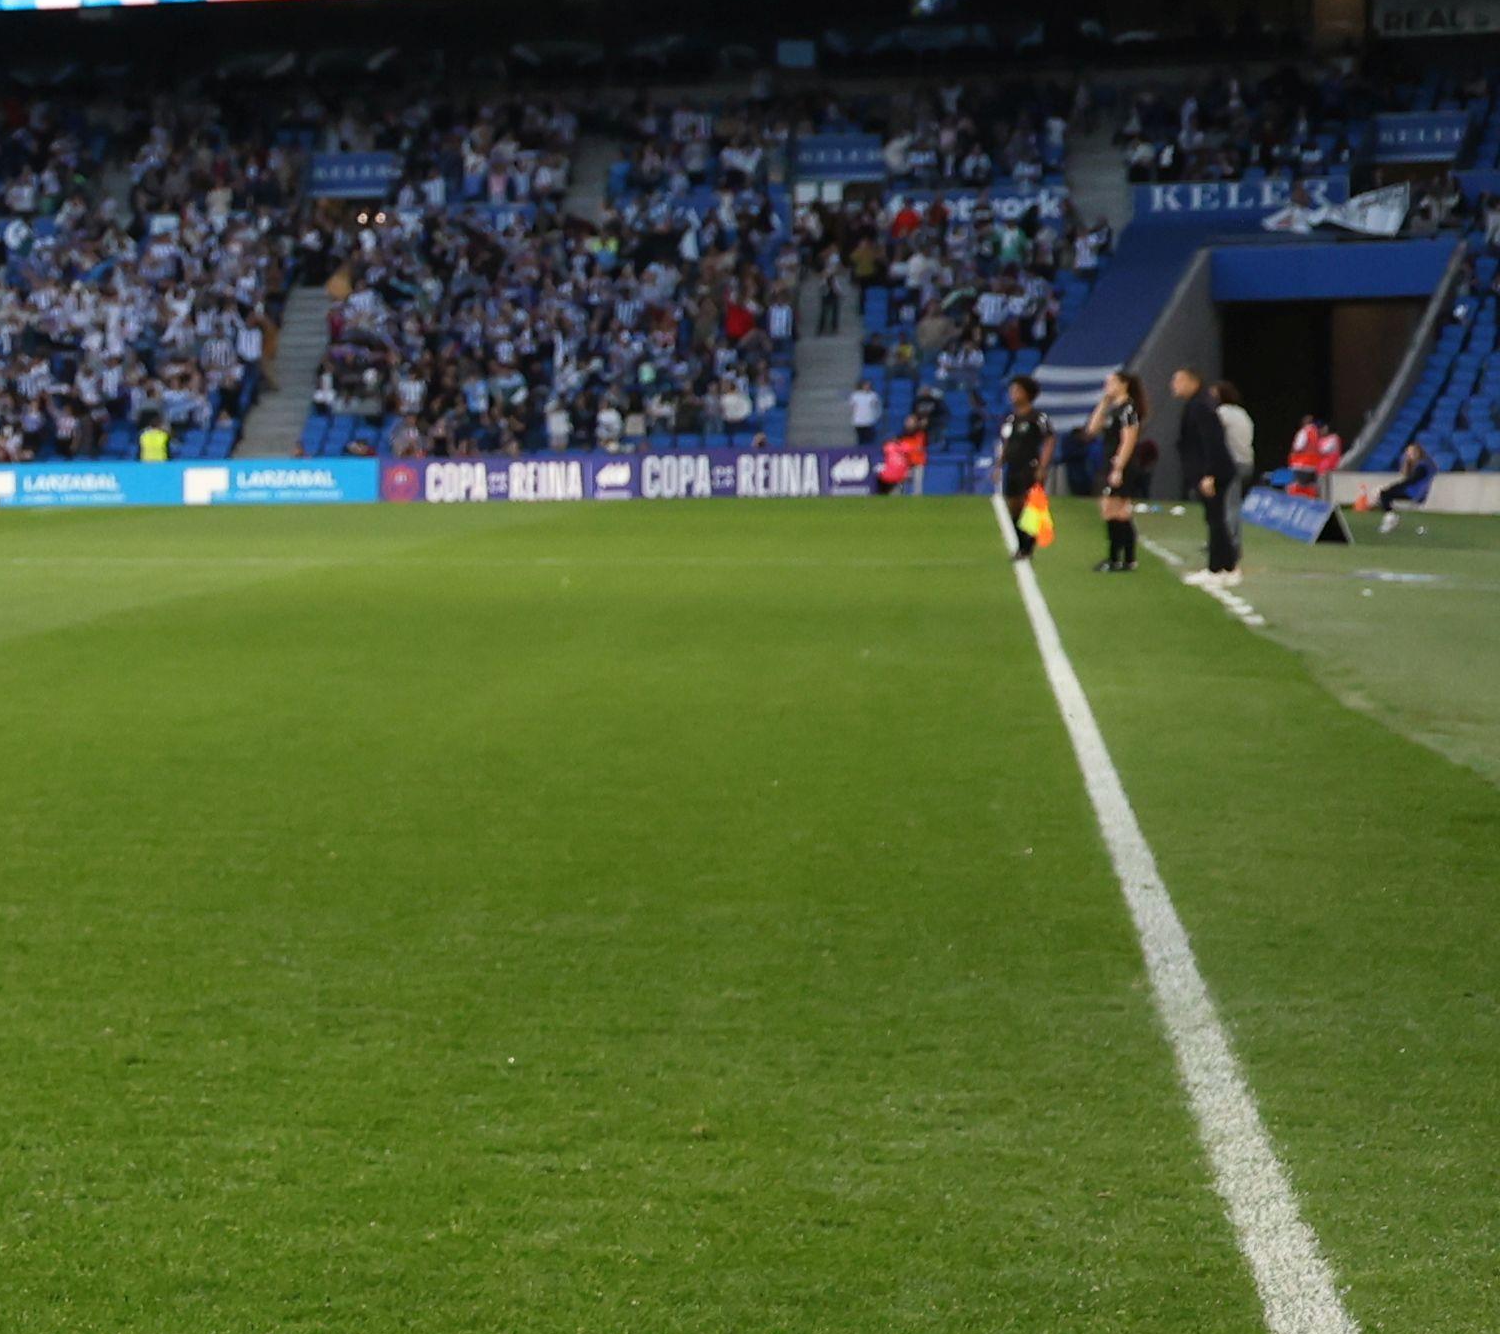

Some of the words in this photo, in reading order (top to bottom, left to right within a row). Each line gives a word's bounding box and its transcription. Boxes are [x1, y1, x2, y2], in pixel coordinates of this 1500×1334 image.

[425, 462, 488, 503] COPA
[508, 461, 583, 502] REINA
[641, 454, 712, 499] COPA
[736, 453, 821, 498] REINA
